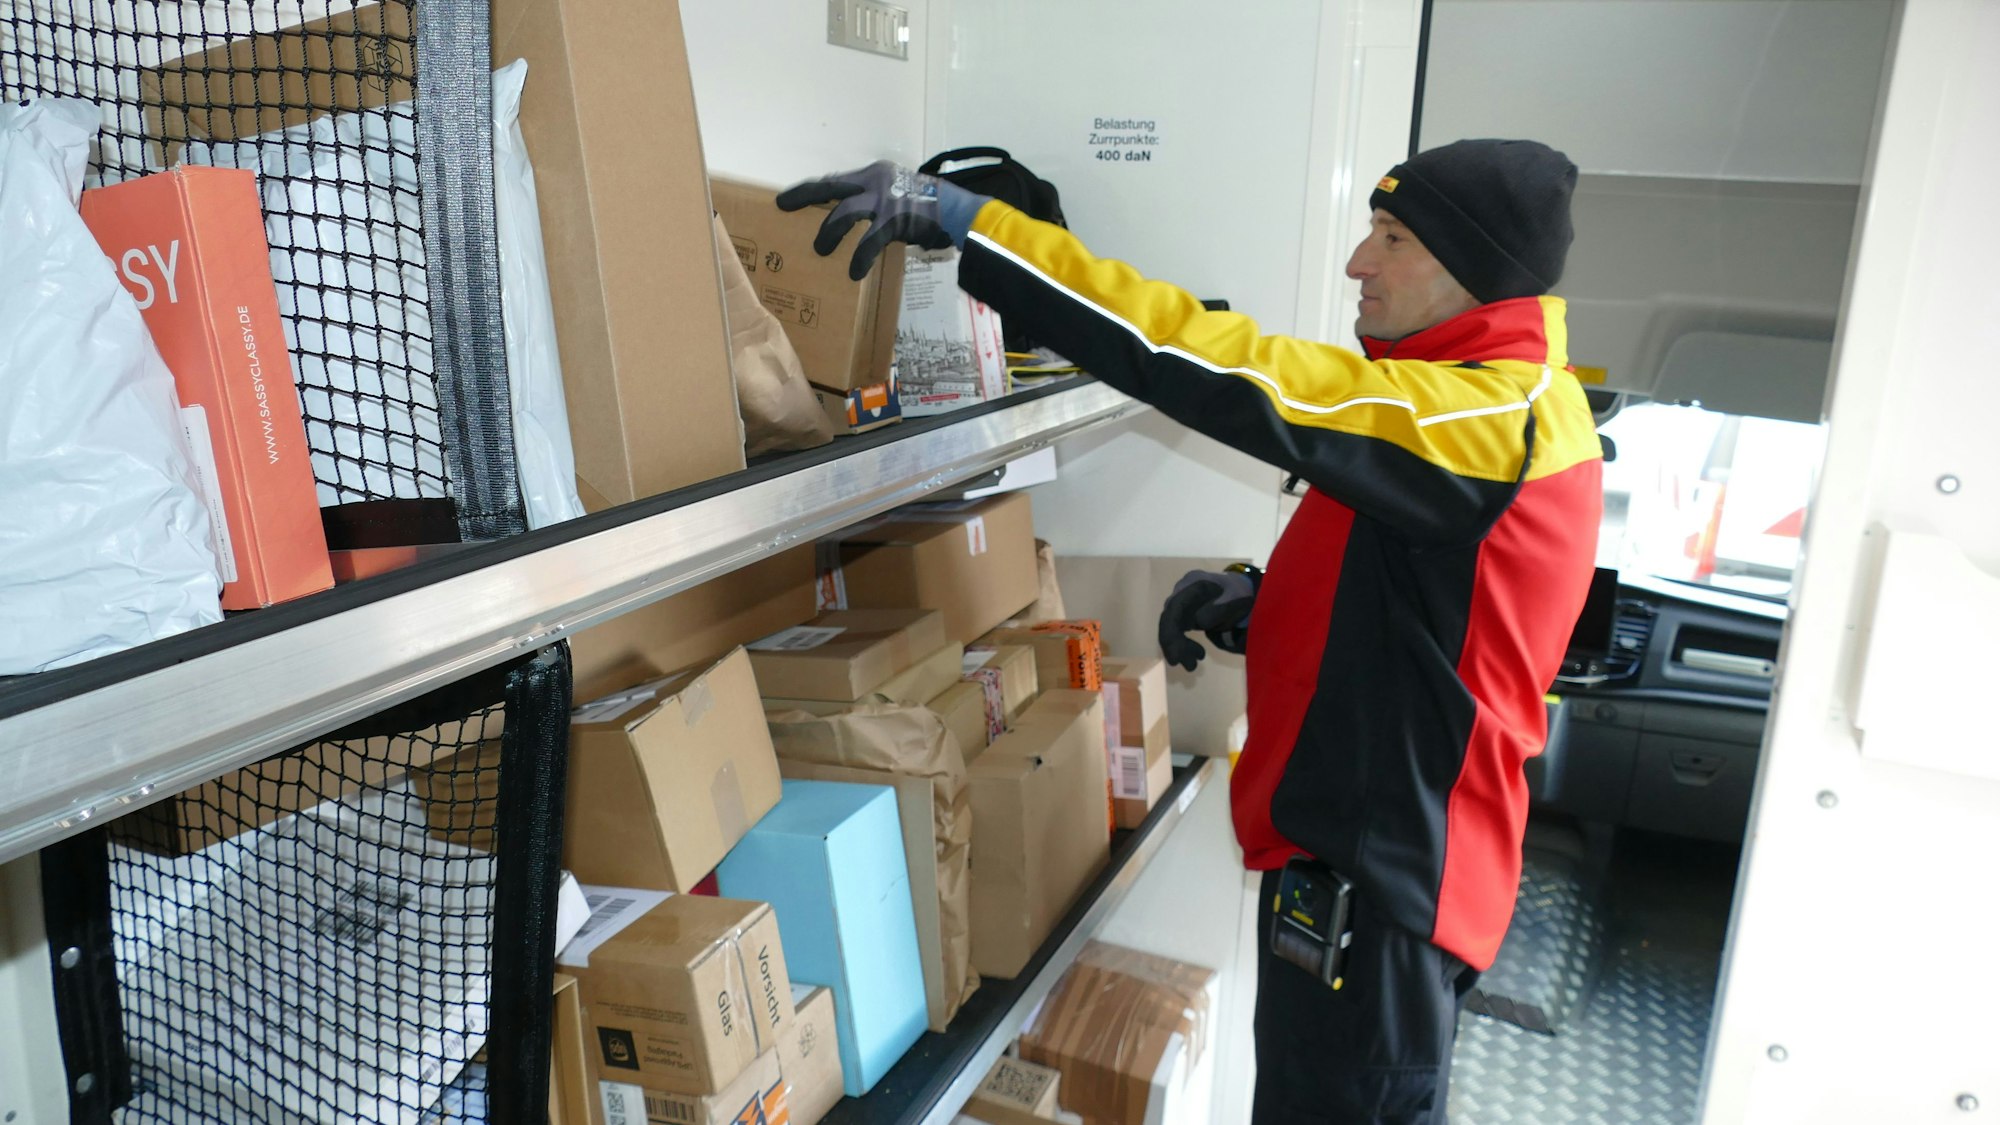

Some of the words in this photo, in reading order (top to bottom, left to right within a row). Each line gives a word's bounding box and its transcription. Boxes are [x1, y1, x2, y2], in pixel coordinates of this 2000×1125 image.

[1088, 133, 1159, 147] Zurrpunkte:
[1094, 118, 1155, 132] Belastung
[1095, 150, 1120, 161] 400
[1125, 150, 1151, 161] daN
[105, 240, 179, 310] SY
[237, 305, 279, 465] WWW.SASSYCLASSY.DE
[757, 945, 781, 1028] Vorsicht
[717, 990, 733, 1037] Glas
